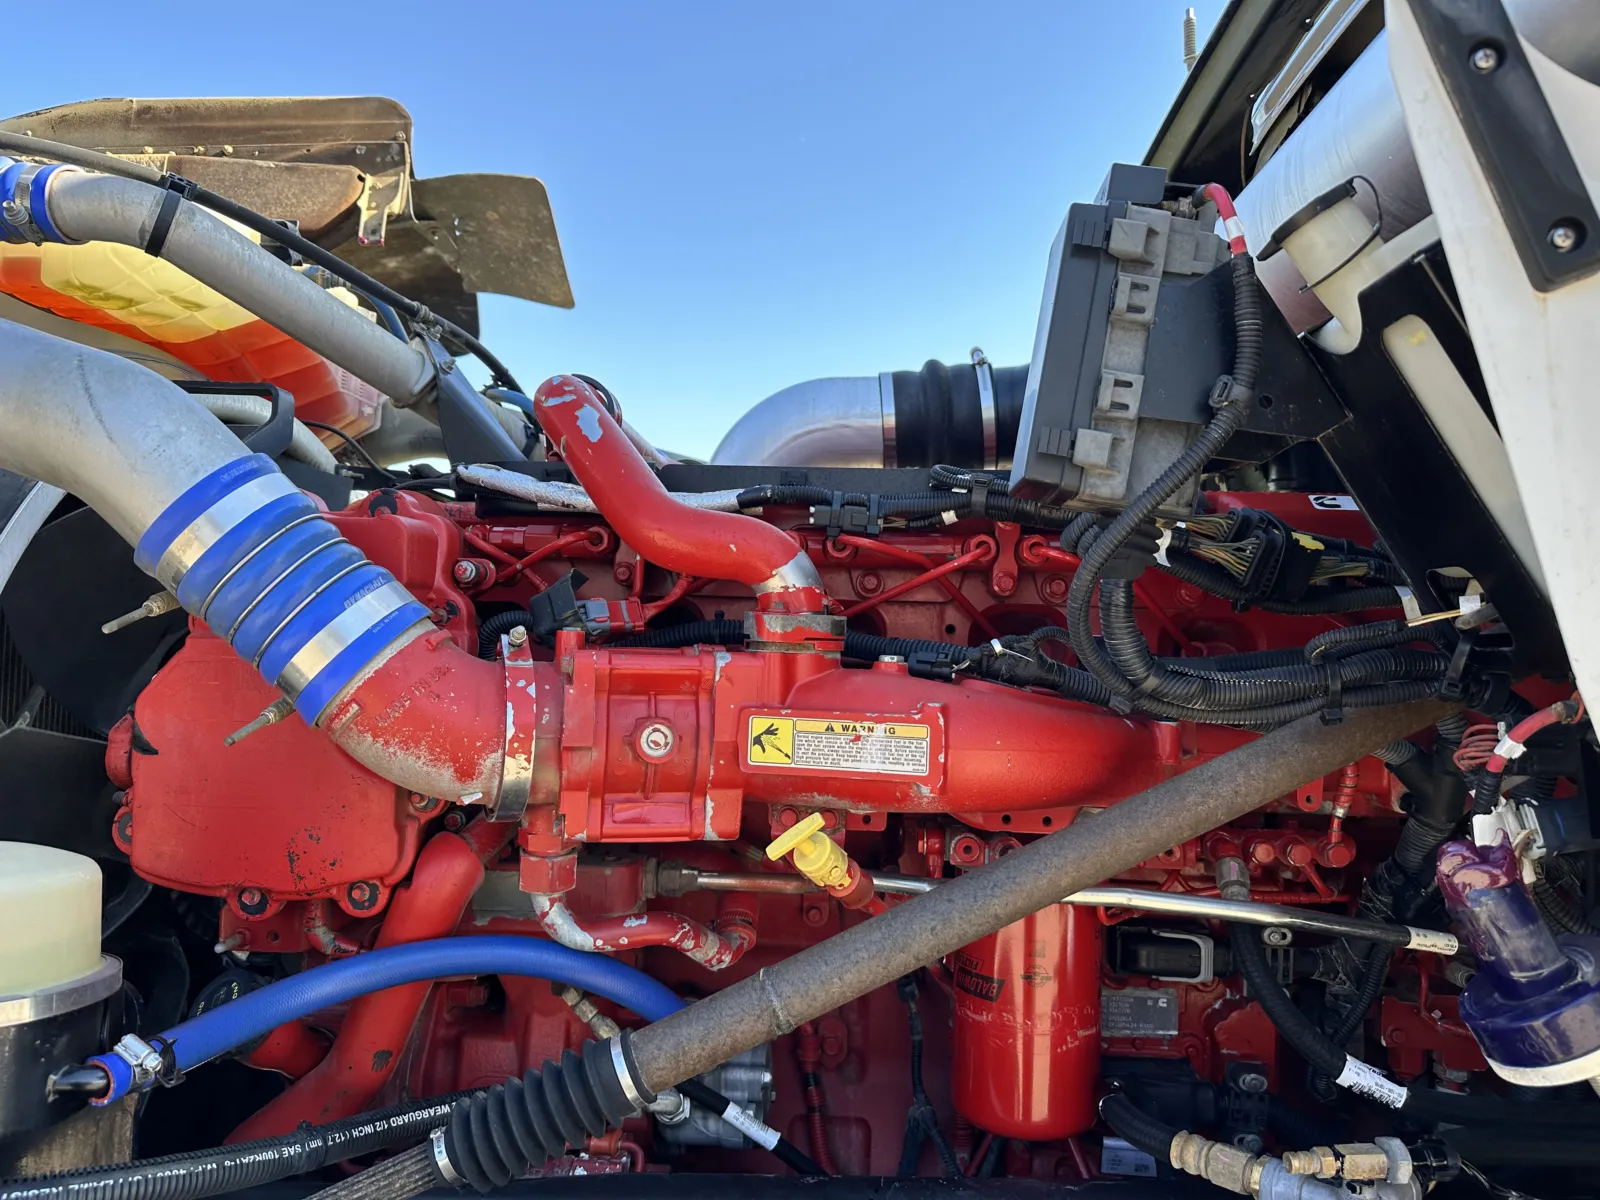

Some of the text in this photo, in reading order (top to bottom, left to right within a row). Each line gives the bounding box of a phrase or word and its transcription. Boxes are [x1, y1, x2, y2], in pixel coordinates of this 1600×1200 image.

[841, 724, 895, 734] WARNG
[390, 1104, 450, 1127] WEARGUARD
[351, 1124, 374, 1138] INCH
[375, 1120, 388, 1131] 1/2
[281, 1143, 302, 1158] SAE
